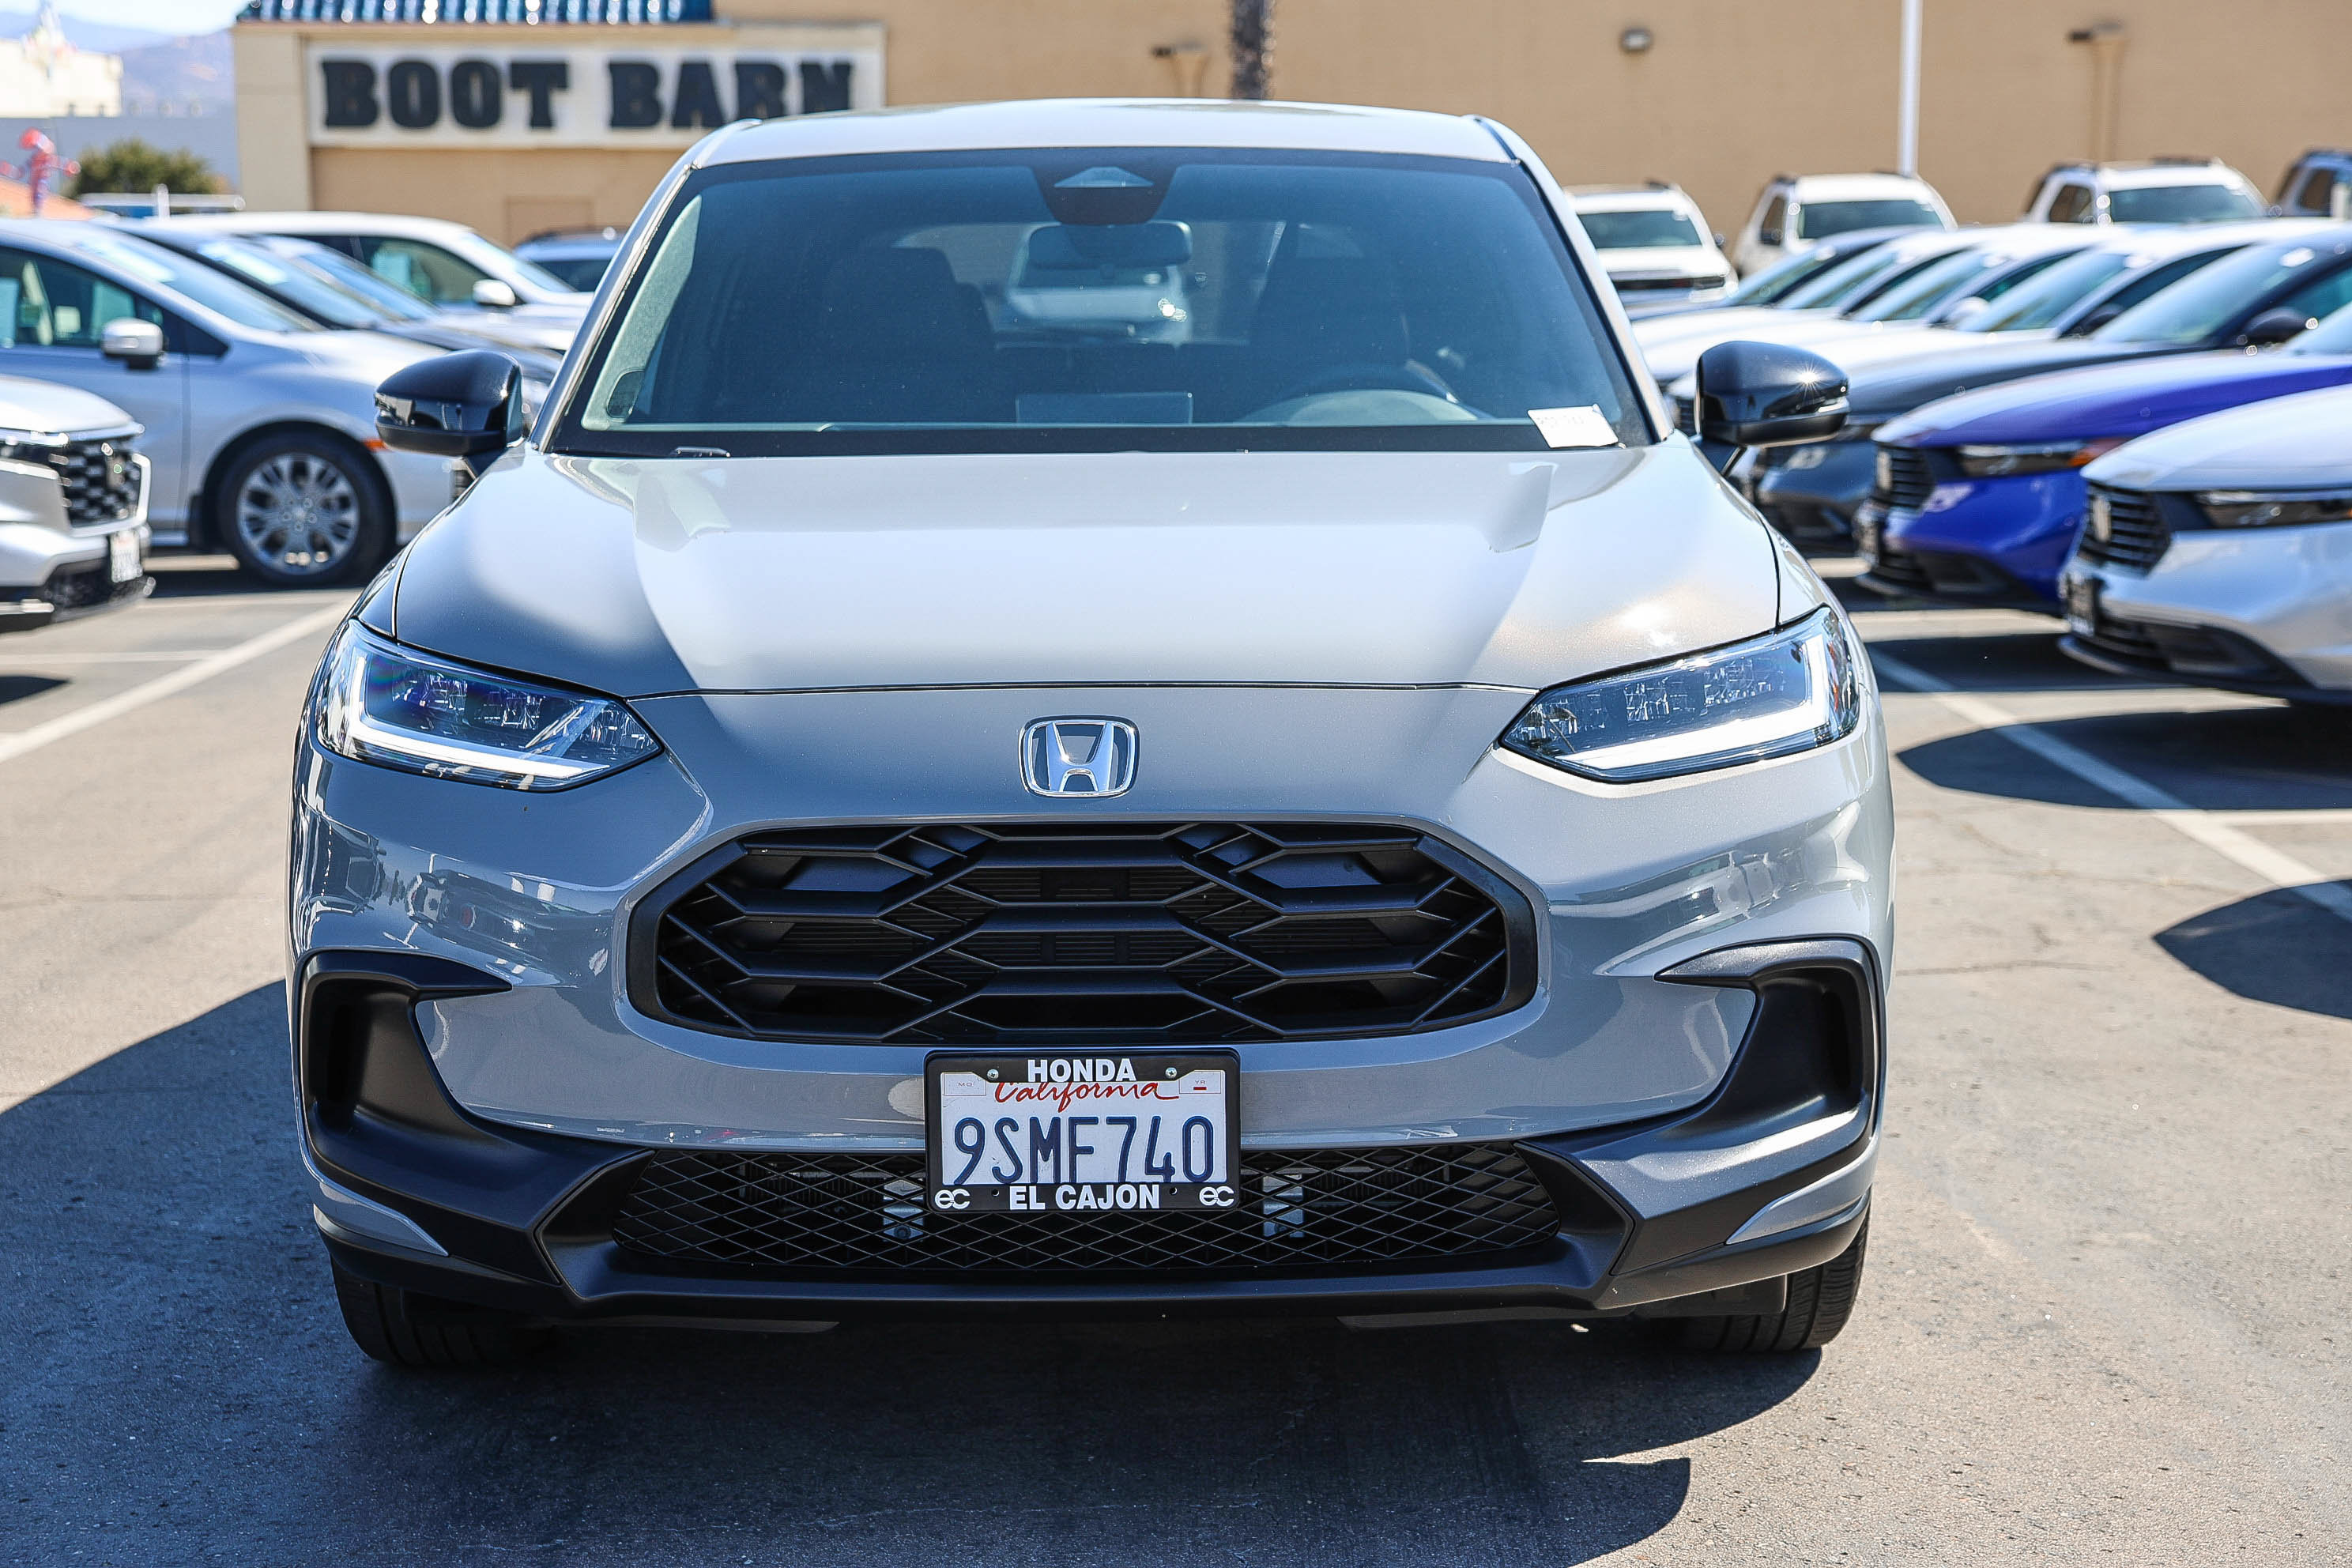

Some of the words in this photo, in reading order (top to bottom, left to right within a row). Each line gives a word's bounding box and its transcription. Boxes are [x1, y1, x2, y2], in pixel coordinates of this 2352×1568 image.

[321, 59, 568, 129] BOOT
[608, 59, 854, 129] BARN
[1027, 1058, 1136, 1082] HONDA
[994, 1081, 1180, 1113] California
[954, 1115, 1214, 1184] 9SMF740
[1008, 1185, 1046, 1210] EL
[1055, 1184, 1160, 1210] CAJON
